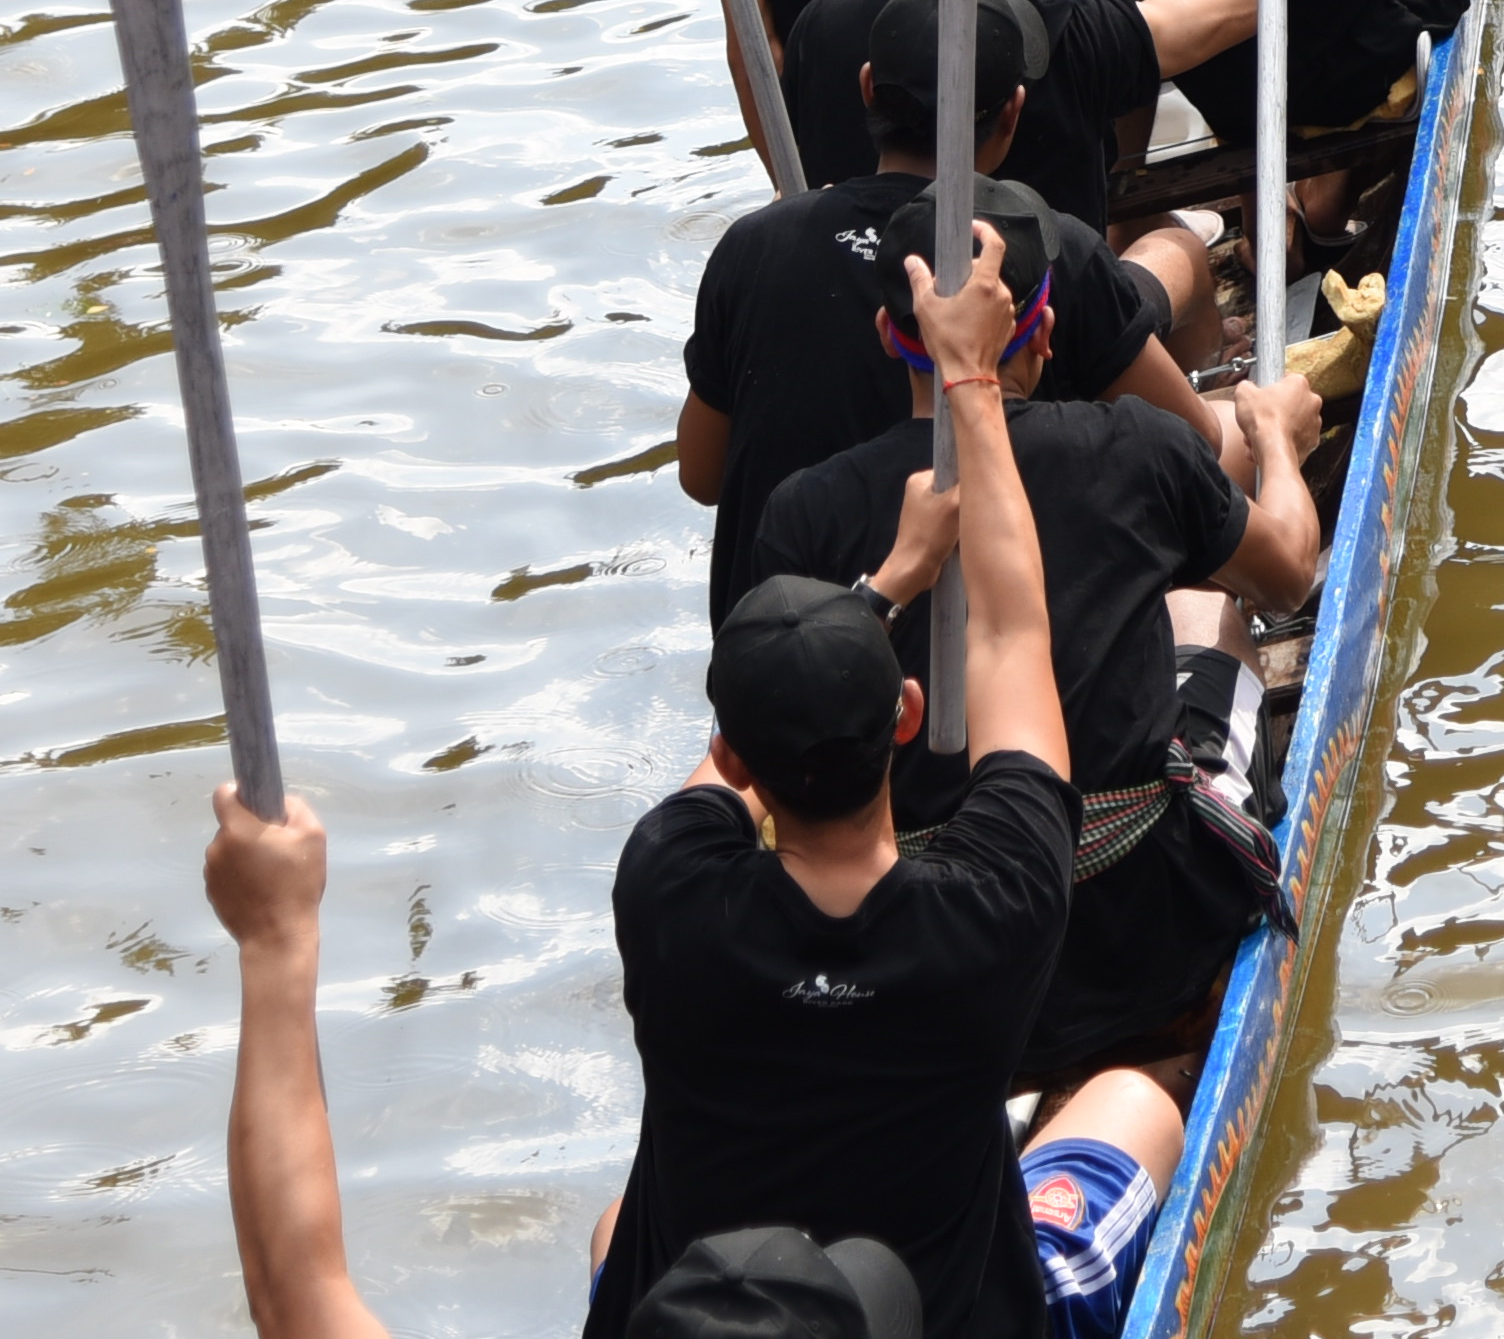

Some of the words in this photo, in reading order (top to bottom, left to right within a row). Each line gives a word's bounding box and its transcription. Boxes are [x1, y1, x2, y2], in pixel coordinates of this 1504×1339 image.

[783, 981, 820, 1000] Jaya
[830, 983, 875, 999] House
[1031, 1205, 1071, 1223] Arsenal
